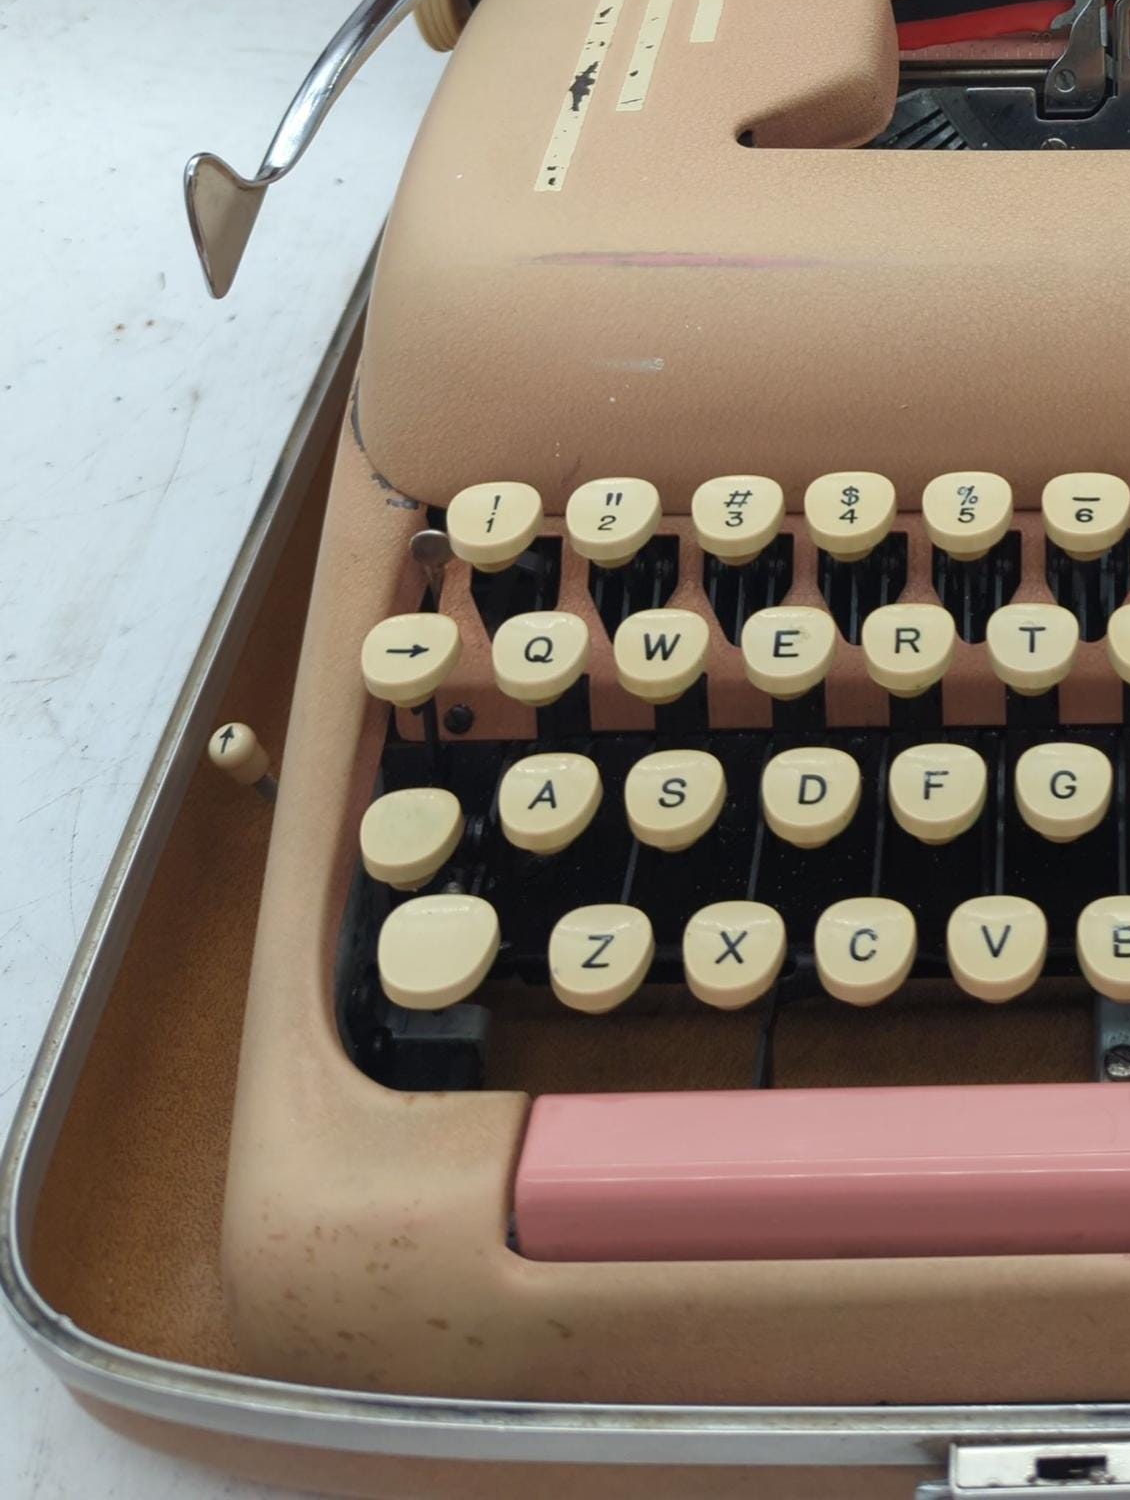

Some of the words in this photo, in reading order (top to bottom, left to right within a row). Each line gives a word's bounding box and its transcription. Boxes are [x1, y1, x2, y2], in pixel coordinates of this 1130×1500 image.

[723, 489, 753, 509] #
[840, 485, 860, 507] $
[597, 514, 617, 531] 2
[724, 510, 744, 528] 3
[838, 508, 858, 525] 4
[957, 507, 976, 524] 5
[1074, 507, 1094, 524] 6
[524, 636, 554, 664] Q
[643, 633, 681, 662] W
[772, 629, 801, 659] E
[894, 627, 921, 655] R
[1018, 626, 1047, 654] T
[527, 779, 558, 811] A
[657, 777, 687, 809] S
[797, 774, 828, 806] D
[923, 770, 950, 801] F
[1049, 770, 1077, 800] G
[580, 934, 615, 969] Z
[714, 930, 748, 965] X
[849, 928, 878, 962] C
[981, 924, 1011, 959] V
